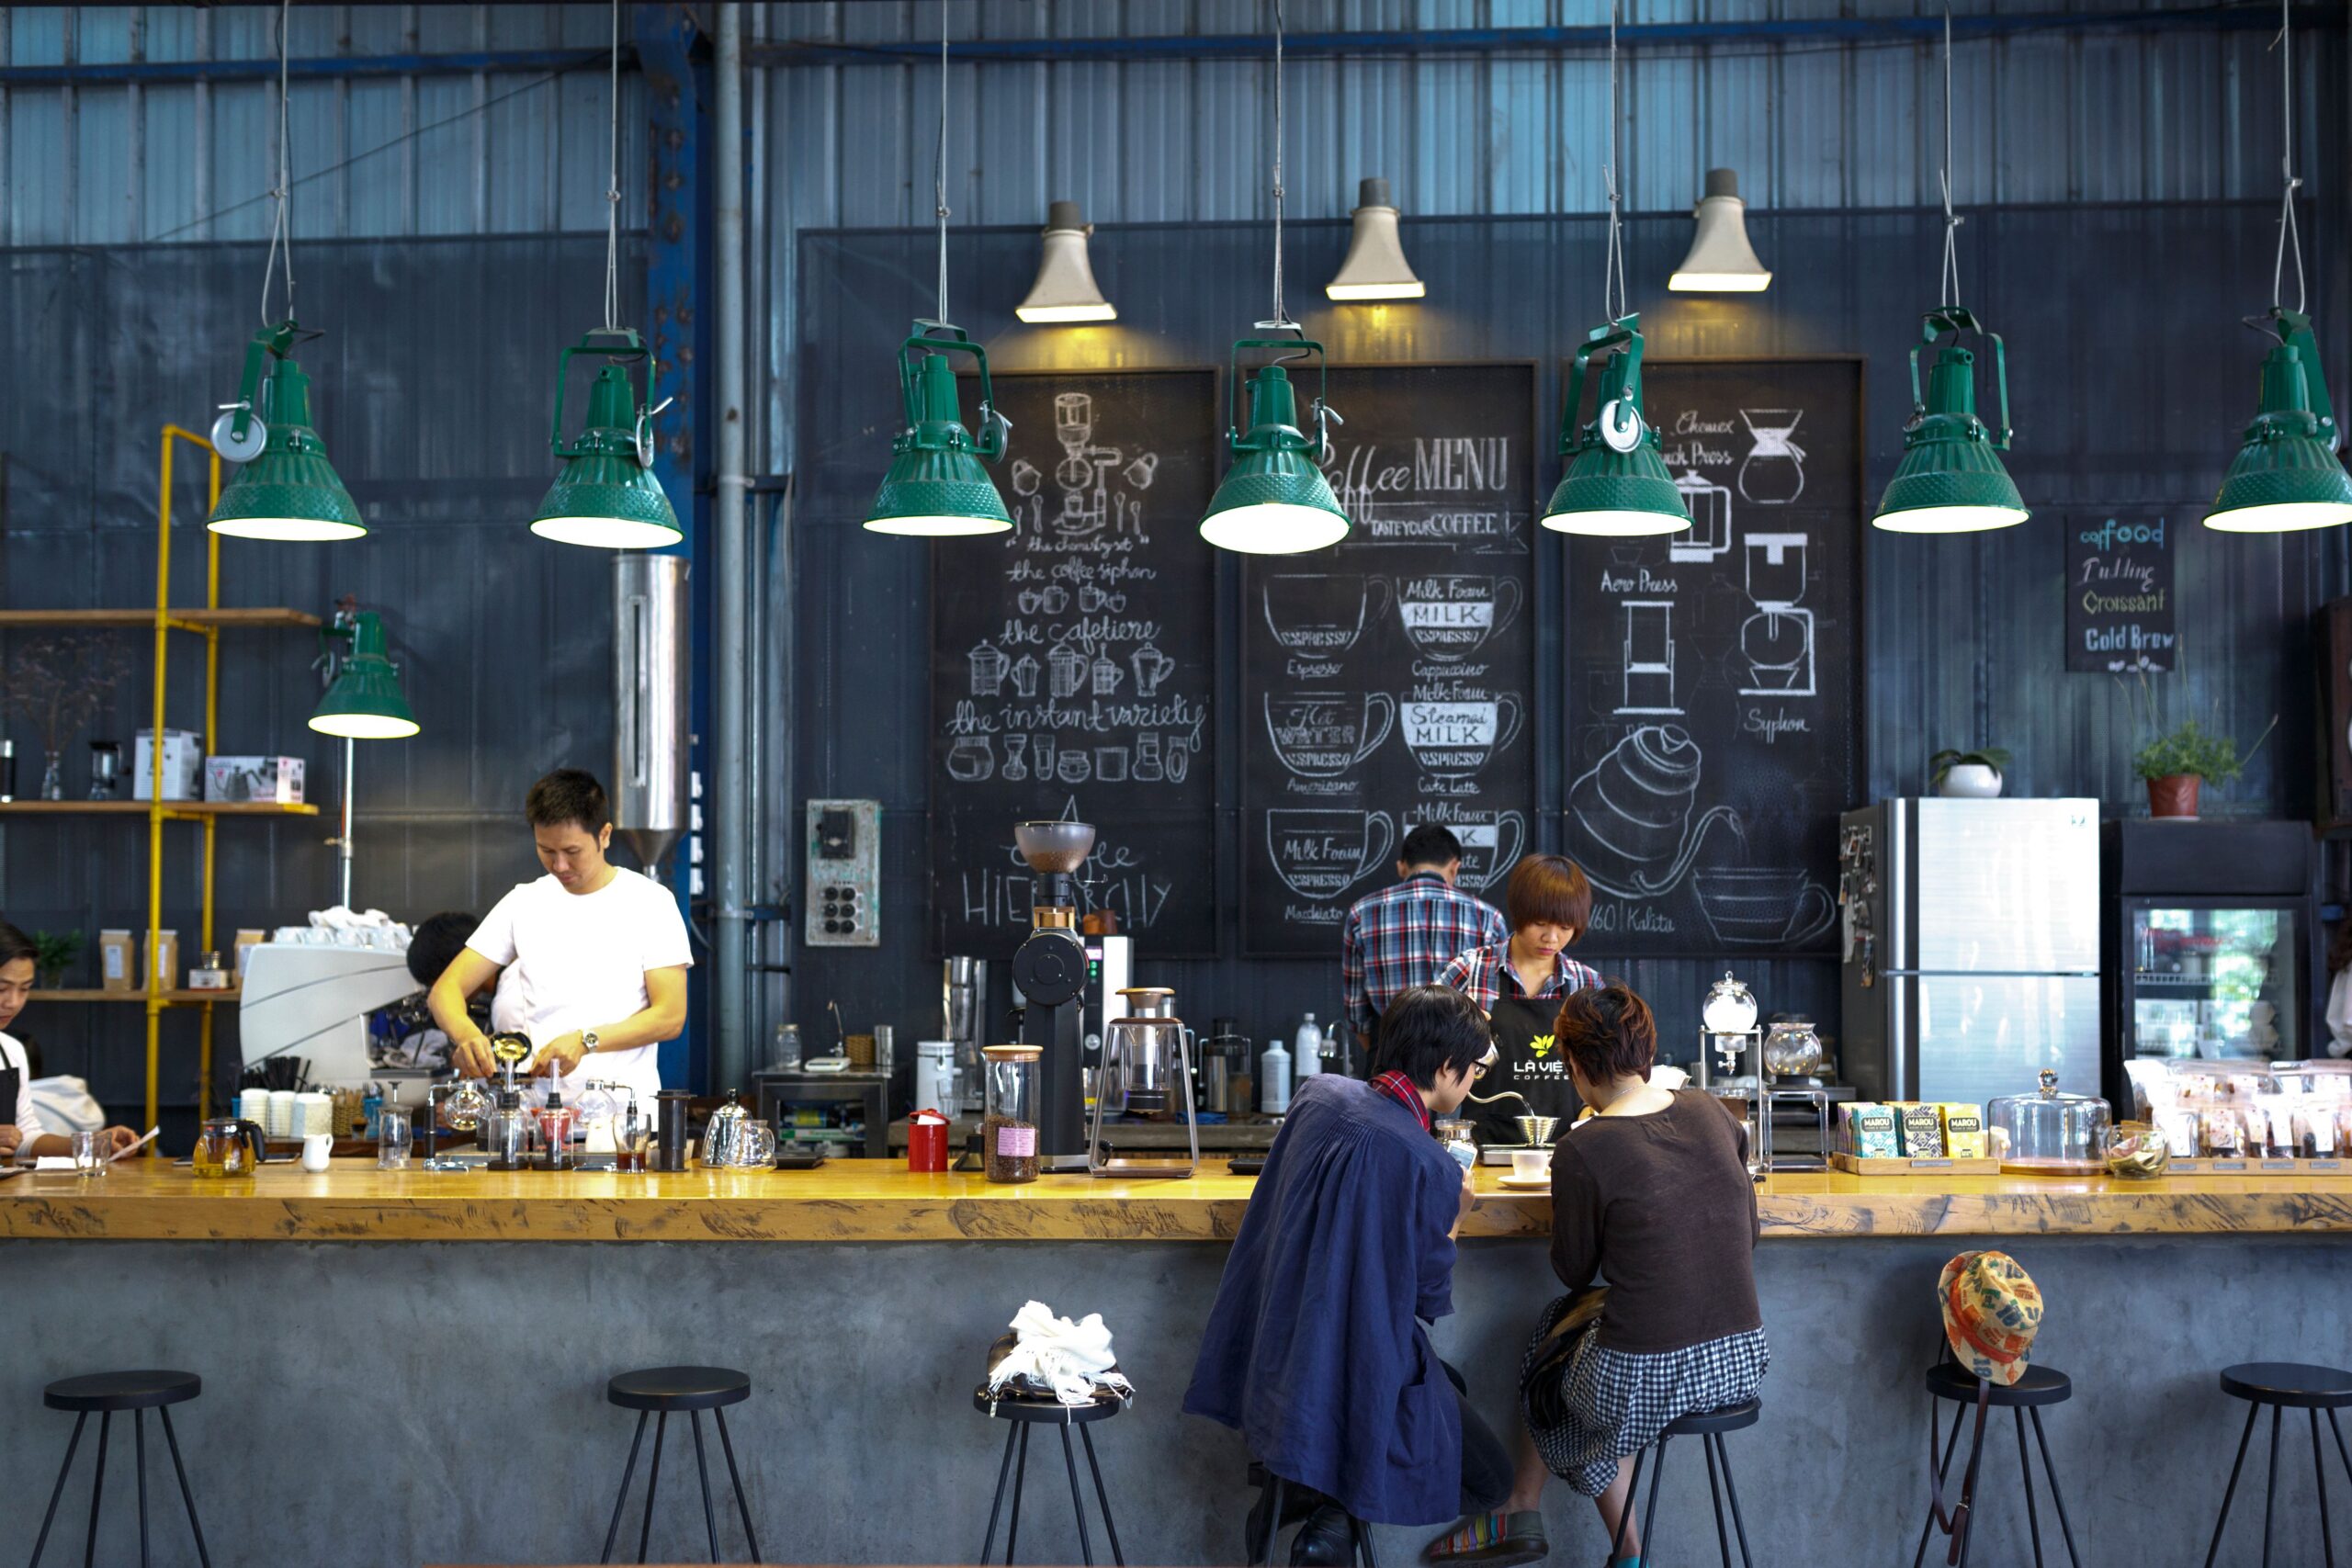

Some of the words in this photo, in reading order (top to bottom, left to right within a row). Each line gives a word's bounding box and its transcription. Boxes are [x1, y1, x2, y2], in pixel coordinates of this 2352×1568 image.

[1691, 440, 1735, 466] Press
[1323, 440, 1411, 525] offee
[1414, 437, 1509, 491] MENU
[1371, 519, 1402, 536] TASTE
[1399, 519, 1432, 536] YOUR
[1430, 511, 1498, 536] COFFEE
[1027, 536, 1053, 551] the
[1006, 558, 1045, 581] the
[1051, 555, 1094, 584] coffee
[1096, 557, 1157, 586] siphon
[1600, 570, 1635, 592] Aero
[1638, 569, 1678, 592] Press
[1406, 578, 1445, 599] Milk
[1449, 578, 1491, 599] Foam
[2083, 589, 2165, 615] Croissant
[1413, 605, 1481, 623] MILK
[1000, 618, 1045, 646] the
[1415, 629, 1479, 643] ESPRESSO
[2085, 625, 2127, 651] Cold
[2131, 625, 2174, 649] Brew
[1413, 682, 1451, 701] Milk
[945, 699, 1001, 735] the
[1000, 697, 1110, 732] instant
[1106, 694, 1206, 752] variety
[1744, 706, 1811, 744] Syphon
[1416, 726, 1481, 743] MILK
[1419, 751, 1485, 766] ESPRESSO
[1417, 801, 1452, 823] Milk
[1283, 838, 1320, 861] Milk
[1323, 837, 1363, 861] Foam
[1287, 874, 1351, 887] ESPRESSO
[1864, 1118, 1890, 1126] MAROU
[1908, 1118, 1934, 1126] MAROU
[1951, 1118, 1977, 1127] MAROU
